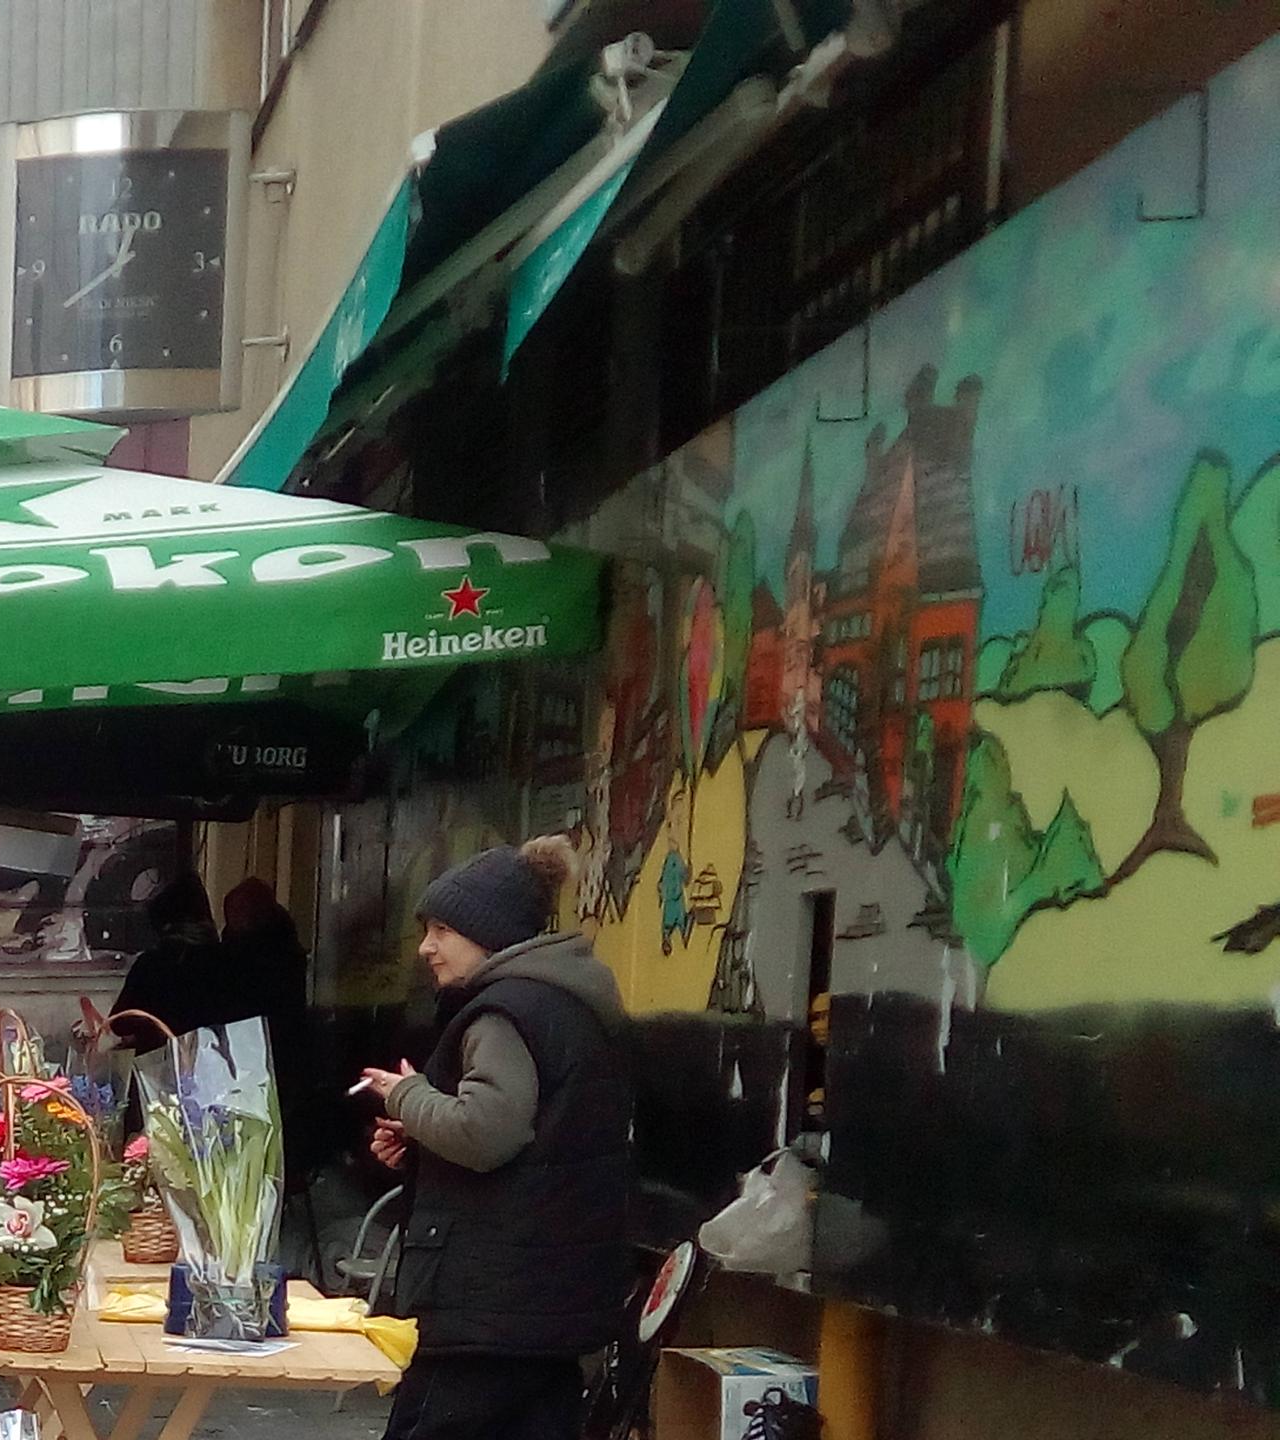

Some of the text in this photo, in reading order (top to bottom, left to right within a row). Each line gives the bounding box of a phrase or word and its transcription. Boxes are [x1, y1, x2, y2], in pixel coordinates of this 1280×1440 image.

[102, 502, 222, 522] MARK
[381, 624, 548, 661] Heineken
[217, 743, 307, 769] UORG
